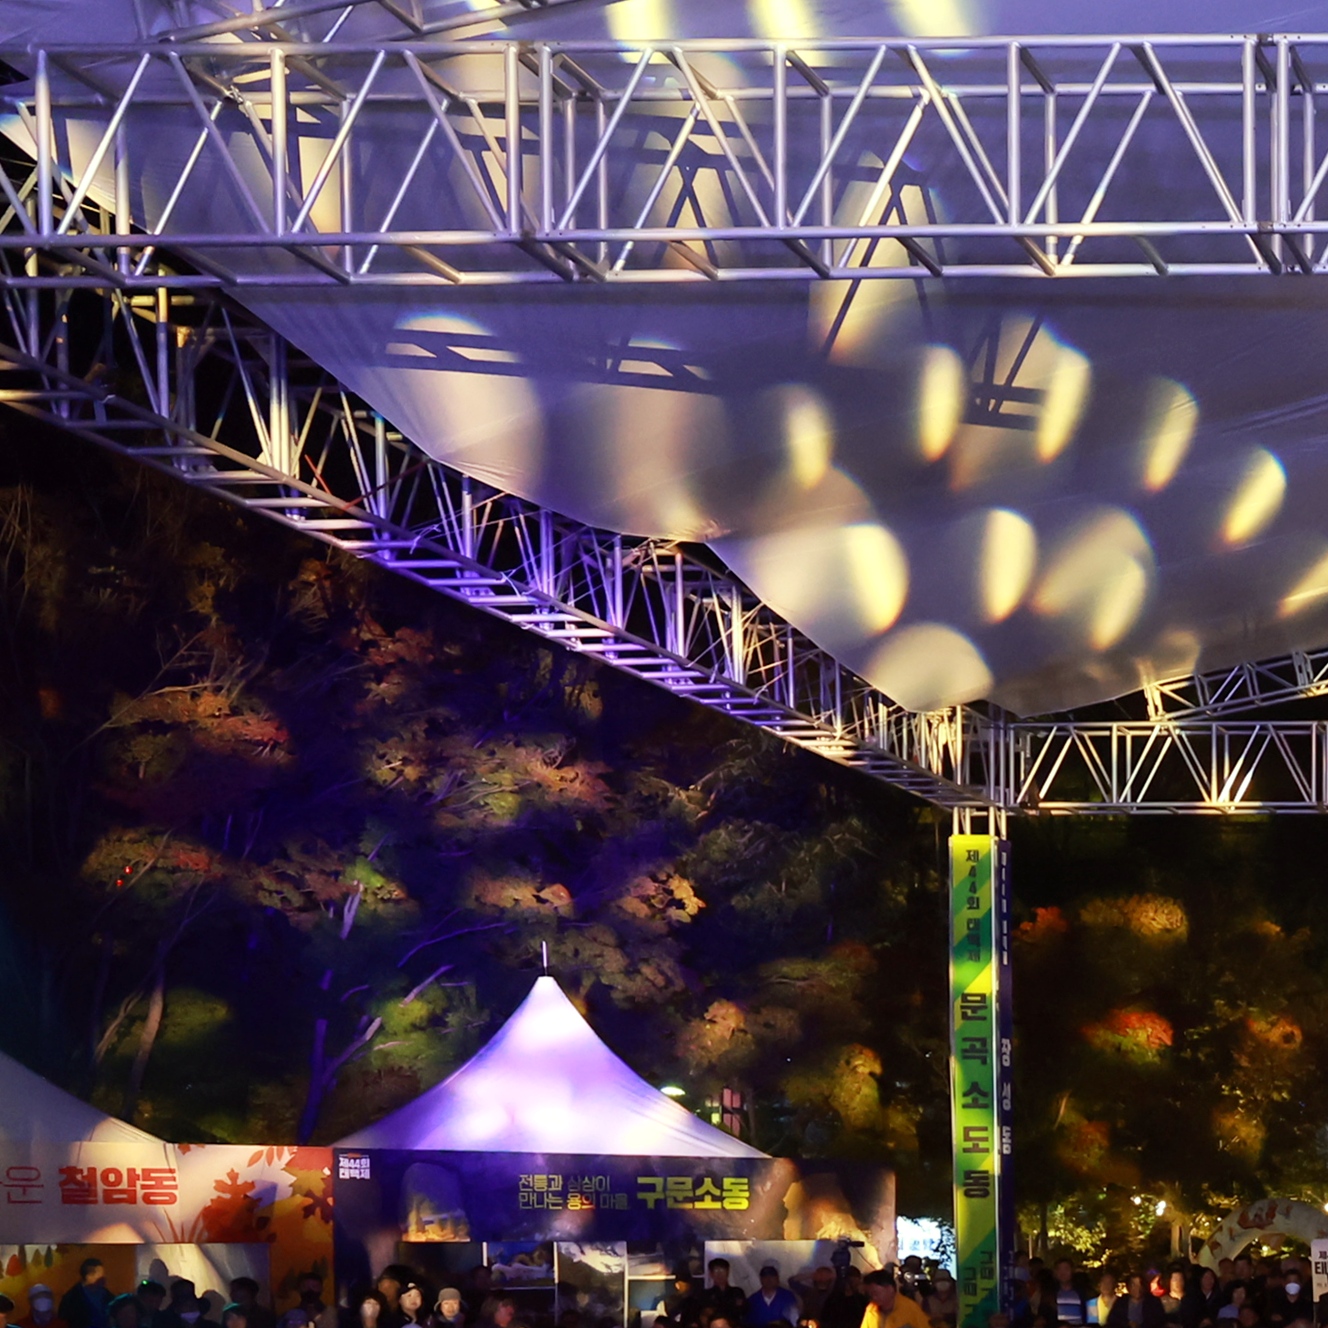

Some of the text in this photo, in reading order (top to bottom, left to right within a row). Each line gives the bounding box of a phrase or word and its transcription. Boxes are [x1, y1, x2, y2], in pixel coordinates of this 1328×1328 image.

[0, 1166, 178, 1205] 운 철암동
[519, 1174, 563, 1192] 전통과
[637, 1176, 750, 1210] 구문소동
[518, 1192, 563, 1210] 만나는
[567, 1192, 596, 1210] 용의
